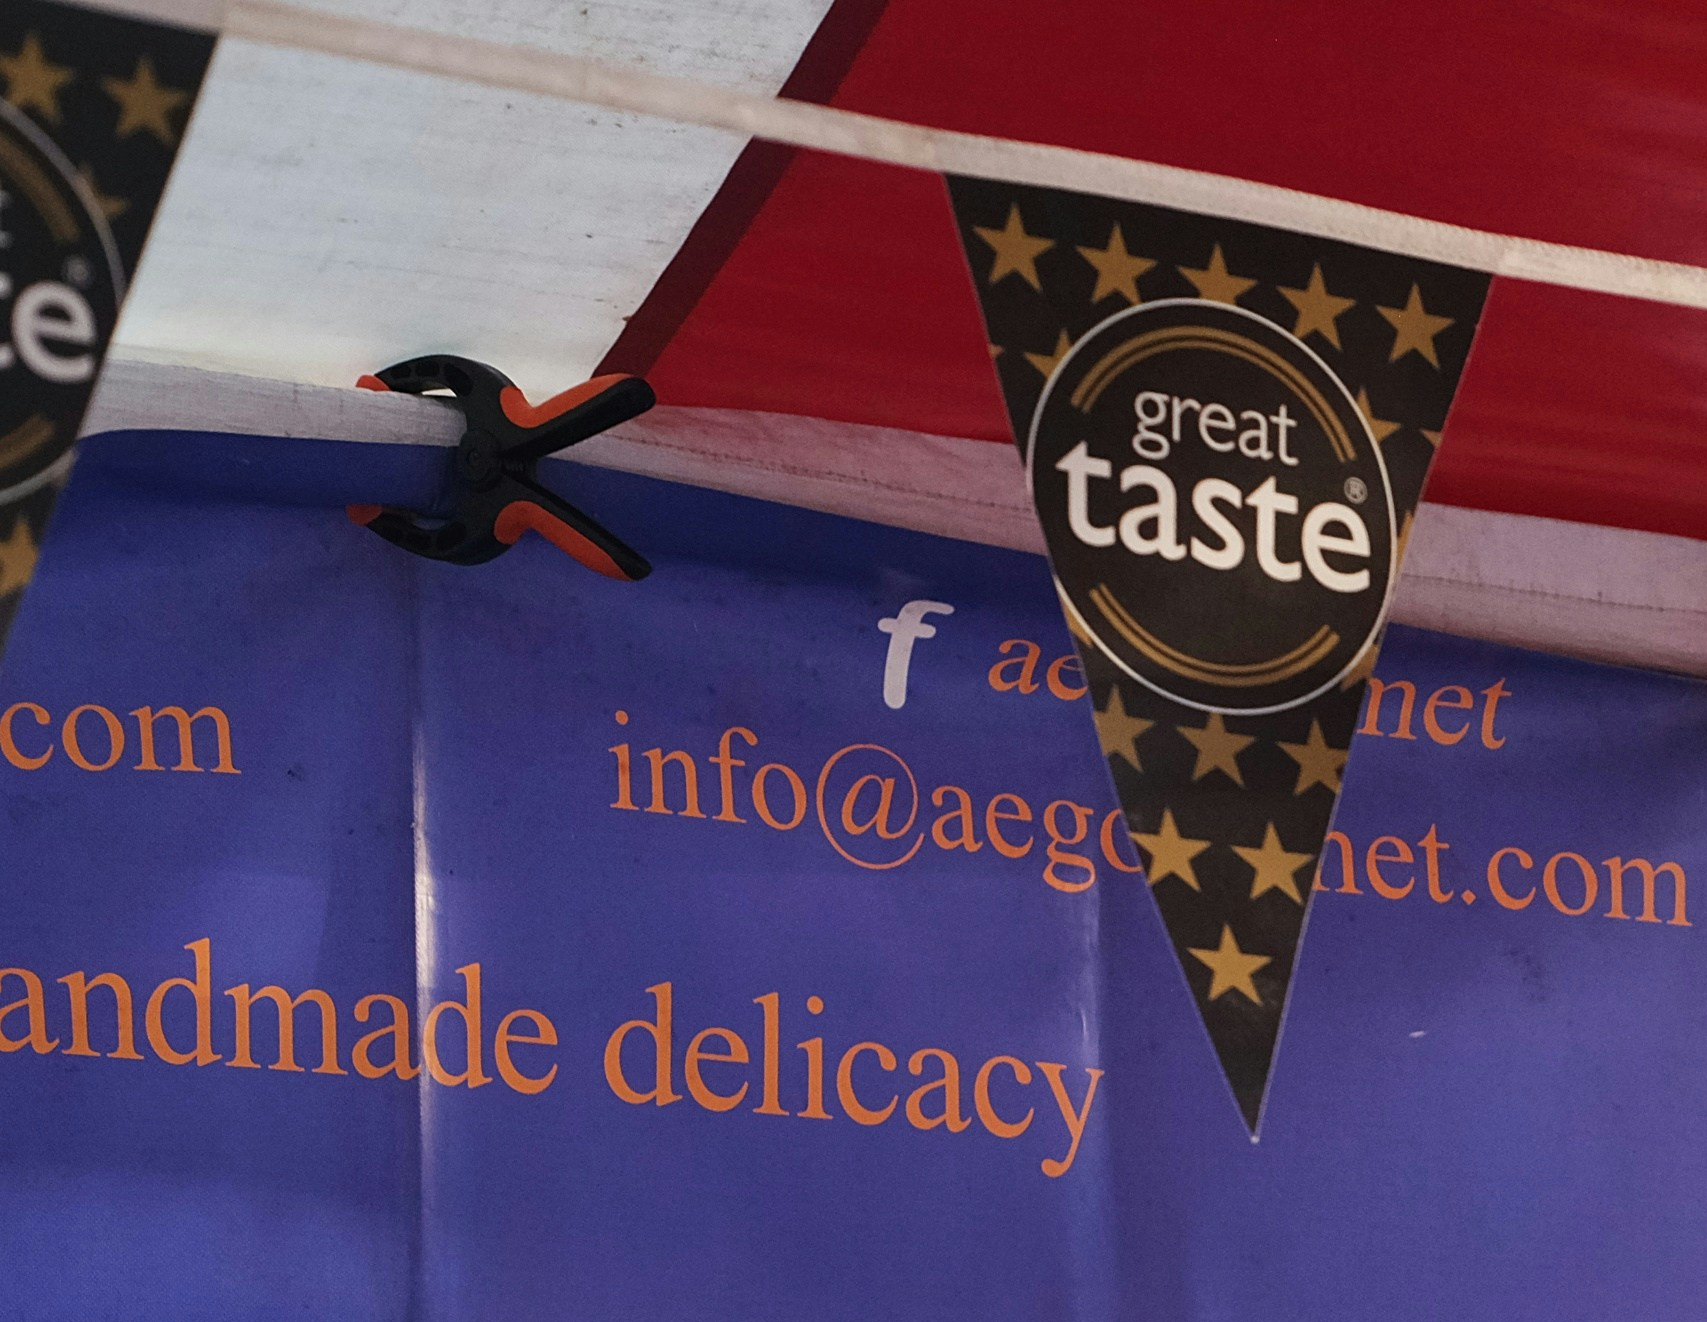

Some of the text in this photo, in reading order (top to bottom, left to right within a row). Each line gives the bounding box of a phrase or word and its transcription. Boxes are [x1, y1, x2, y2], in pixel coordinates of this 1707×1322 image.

[1133, 390, 1298, 466] great
[1054, 440, 1372, 592] taste
[0, 938, 1106, 1179] andmade delicacy
